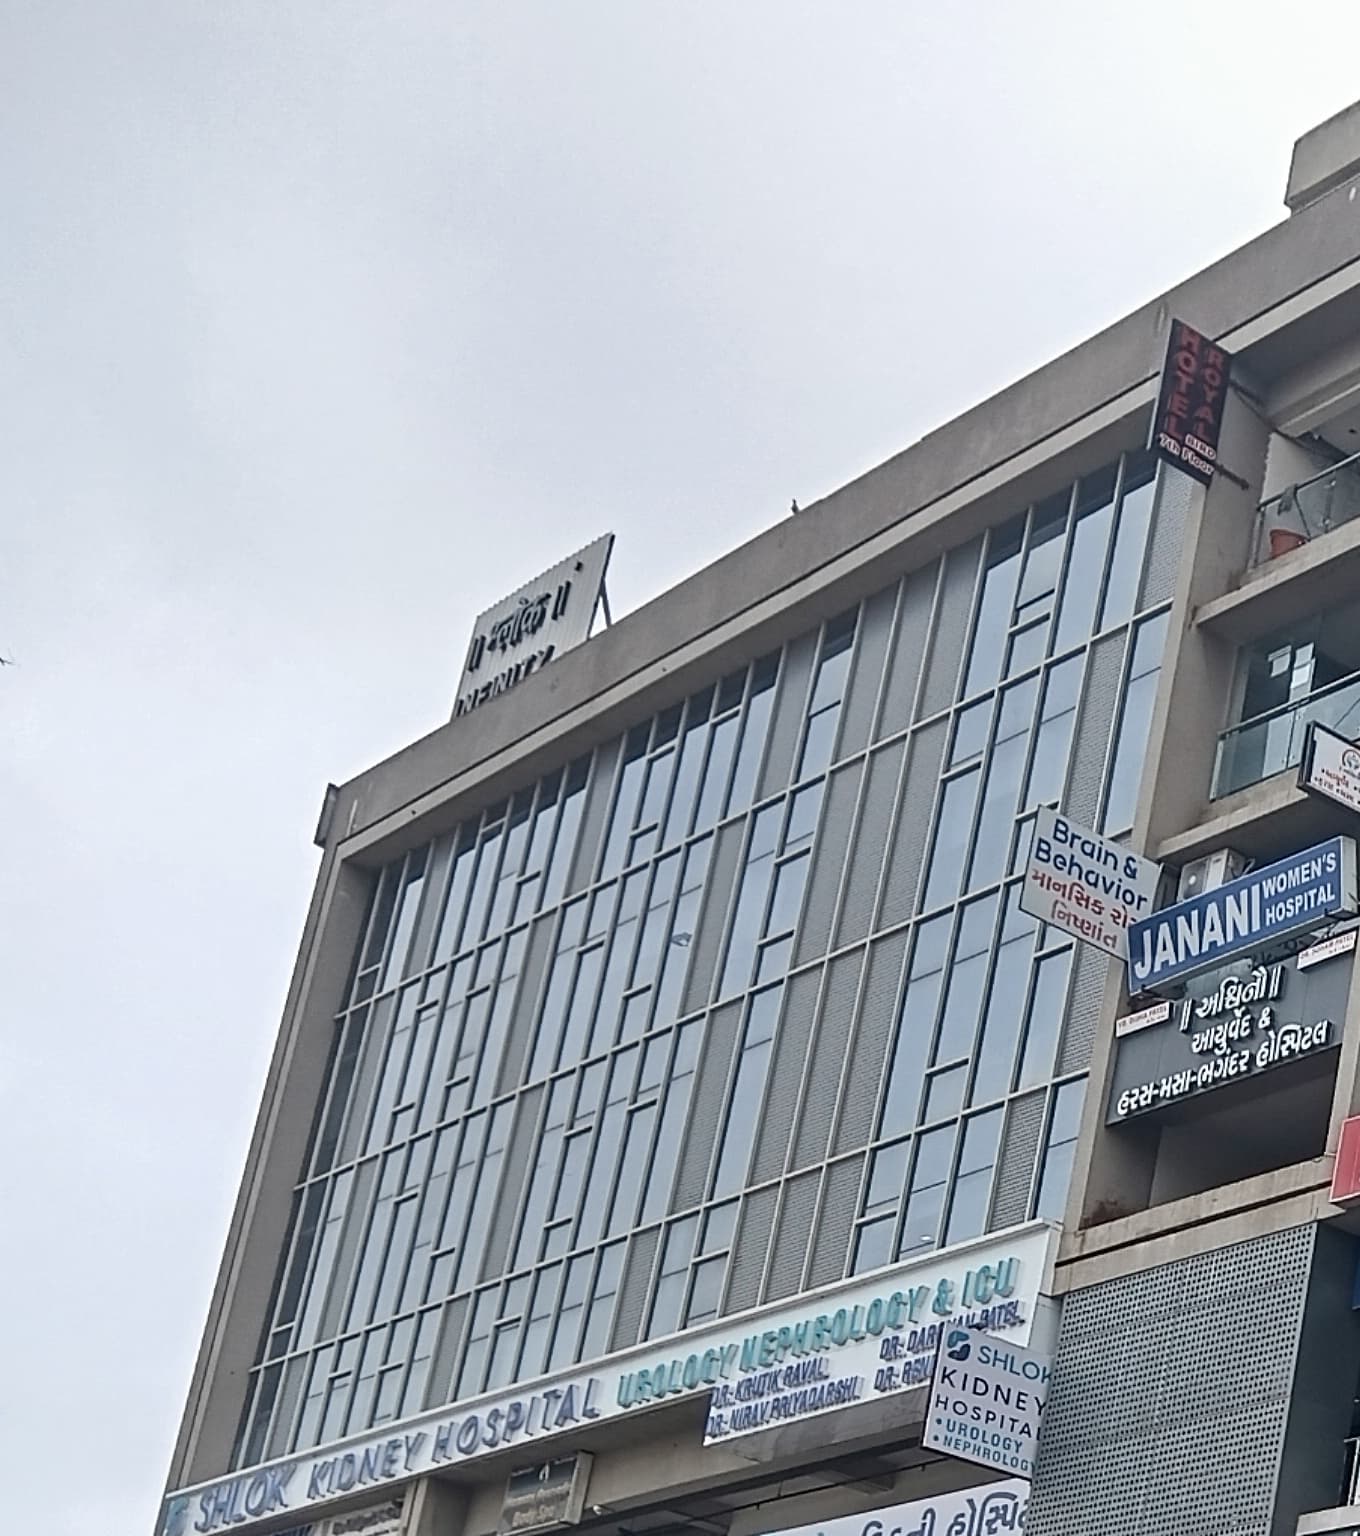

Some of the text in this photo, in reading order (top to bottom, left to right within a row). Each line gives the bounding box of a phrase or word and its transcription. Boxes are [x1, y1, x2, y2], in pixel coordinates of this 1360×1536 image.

[1163, 325, 1197, 439] HOTEL
[1184, 432, 1217, 460] BIRD
[1035, 838, 1148, 912] Behavior
[1052, 818, 1140, 878] Brain &
[1135, 886, 1261, 980] JANANI
[1265, 886, 1335, 927] HOSPITAL
[194, 1257, 1020, 1535] SHLOK KIDNEY HOSPITAL UROLOGY NEPHROLOGY & ICU
[946, 1418, 1024, 1453] UROLOGY
